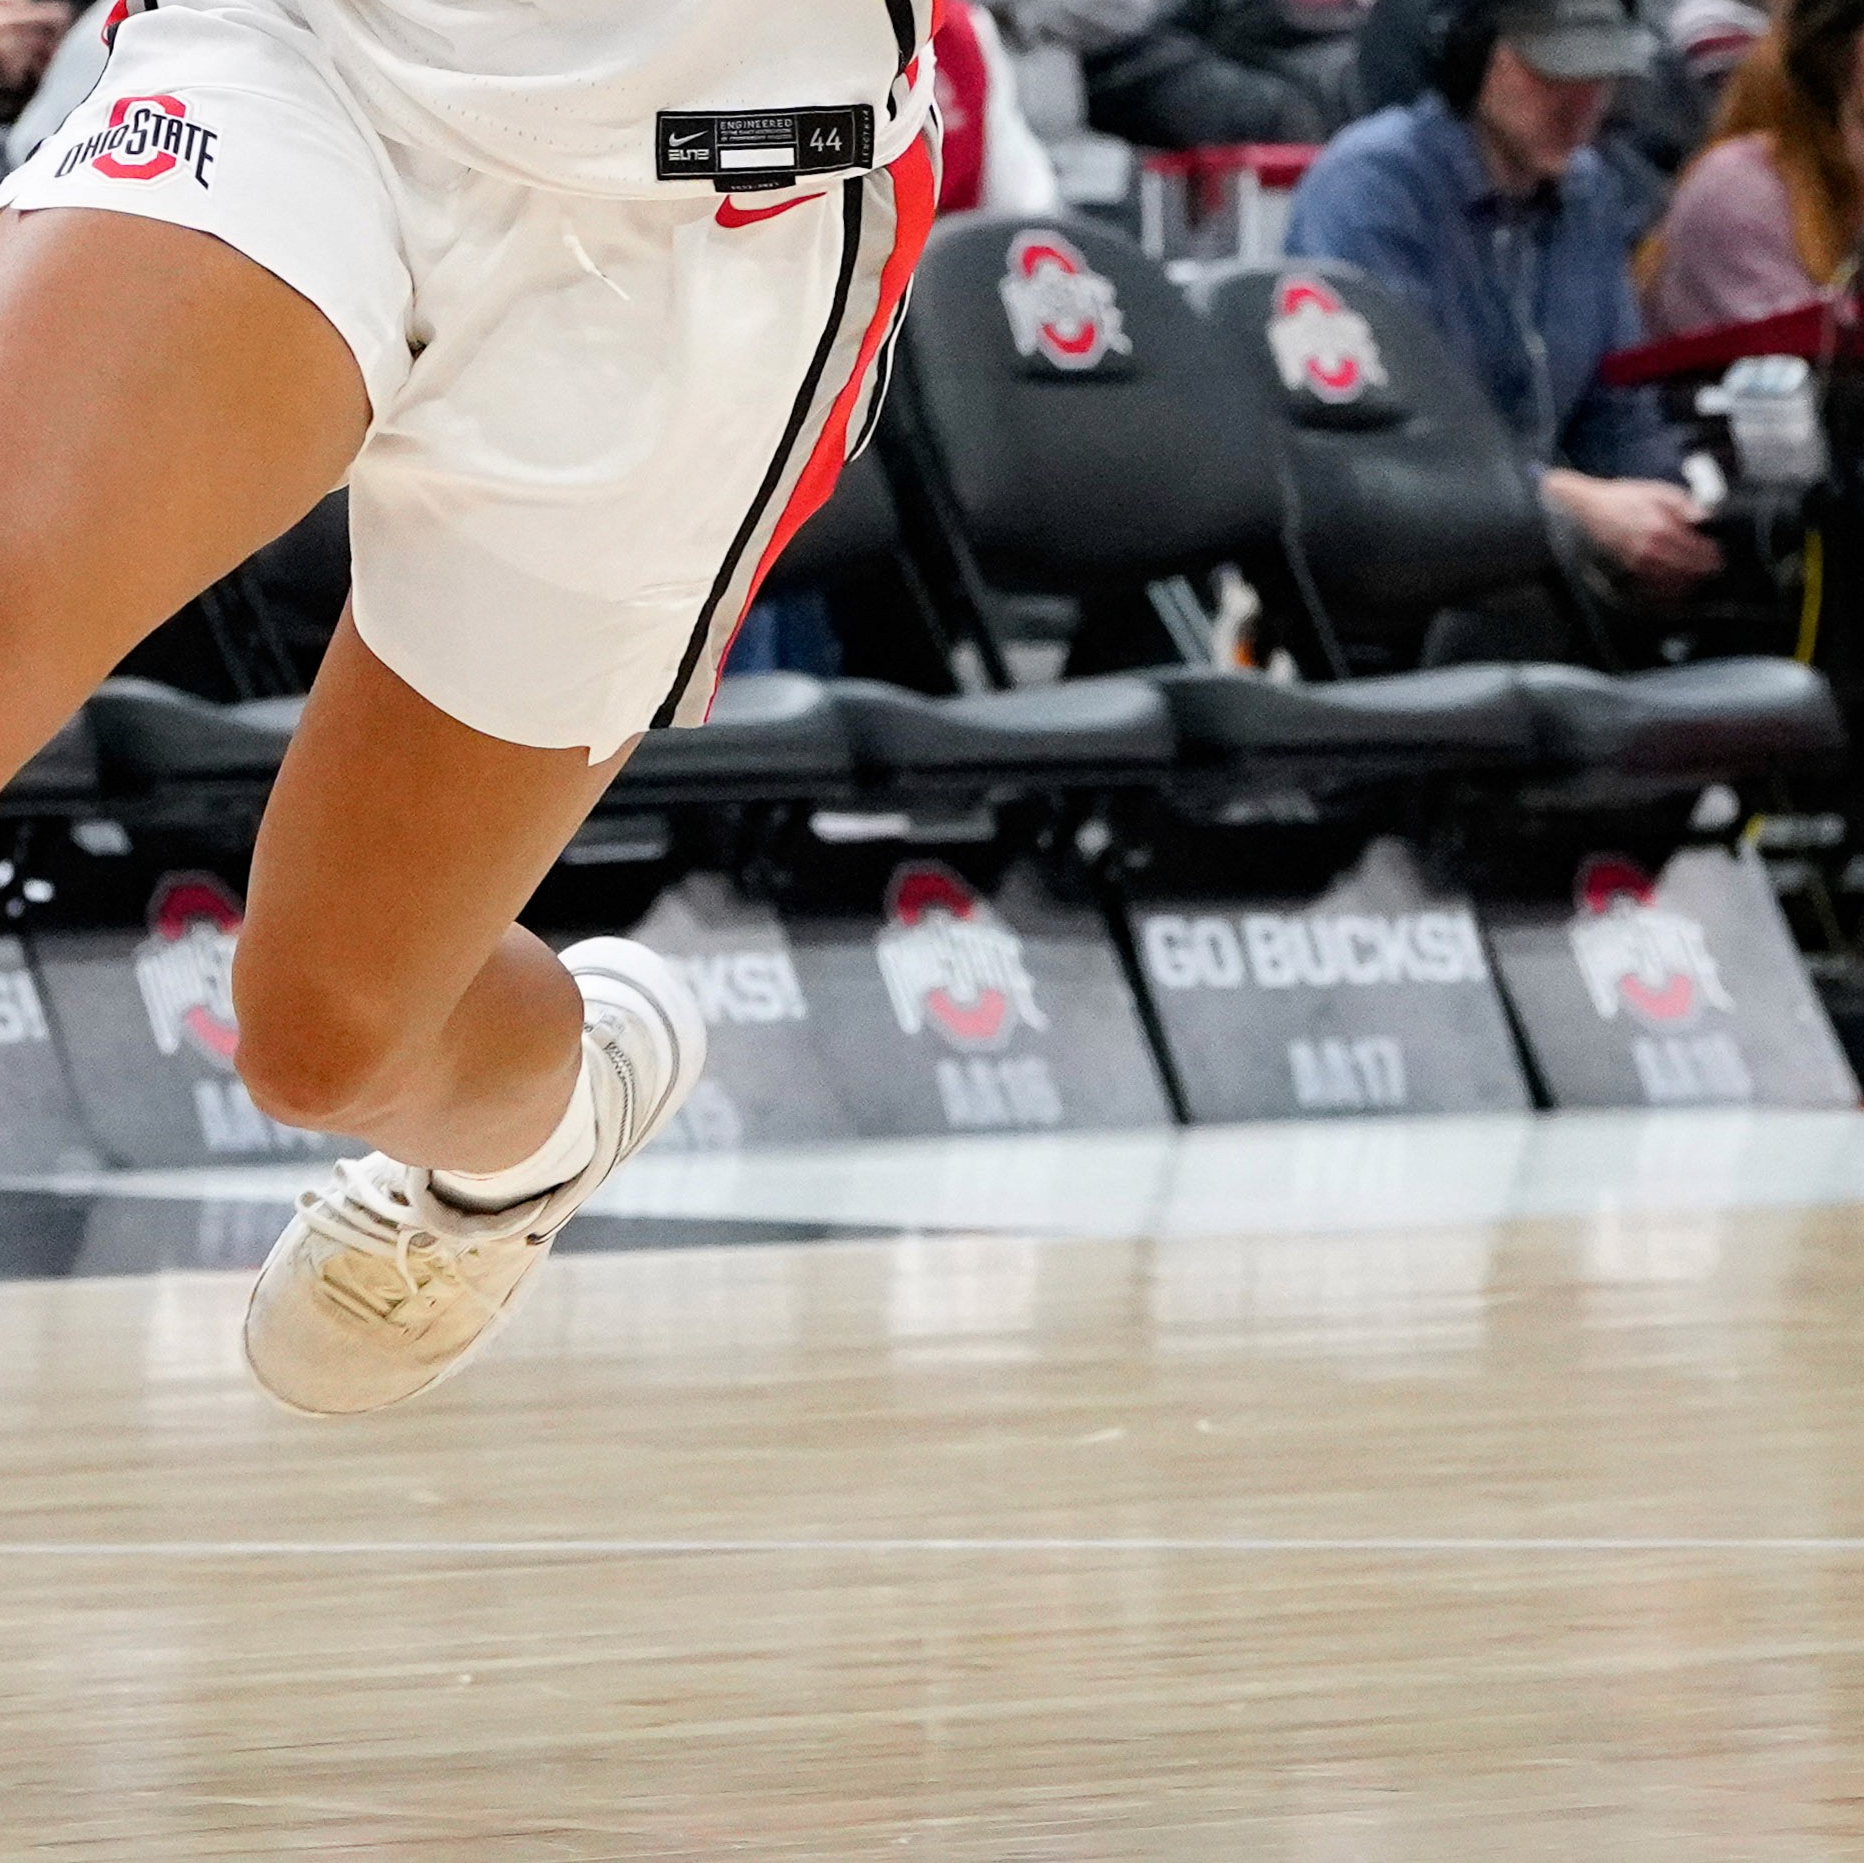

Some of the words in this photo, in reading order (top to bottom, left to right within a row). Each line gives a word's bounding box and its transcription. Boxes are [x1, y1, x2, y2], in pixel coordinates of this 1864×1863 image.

[720, 118, 793, 131] ENGINEERED
[810, 127, 843, 152] 44
[1144, 915, 1243, 988] GO
